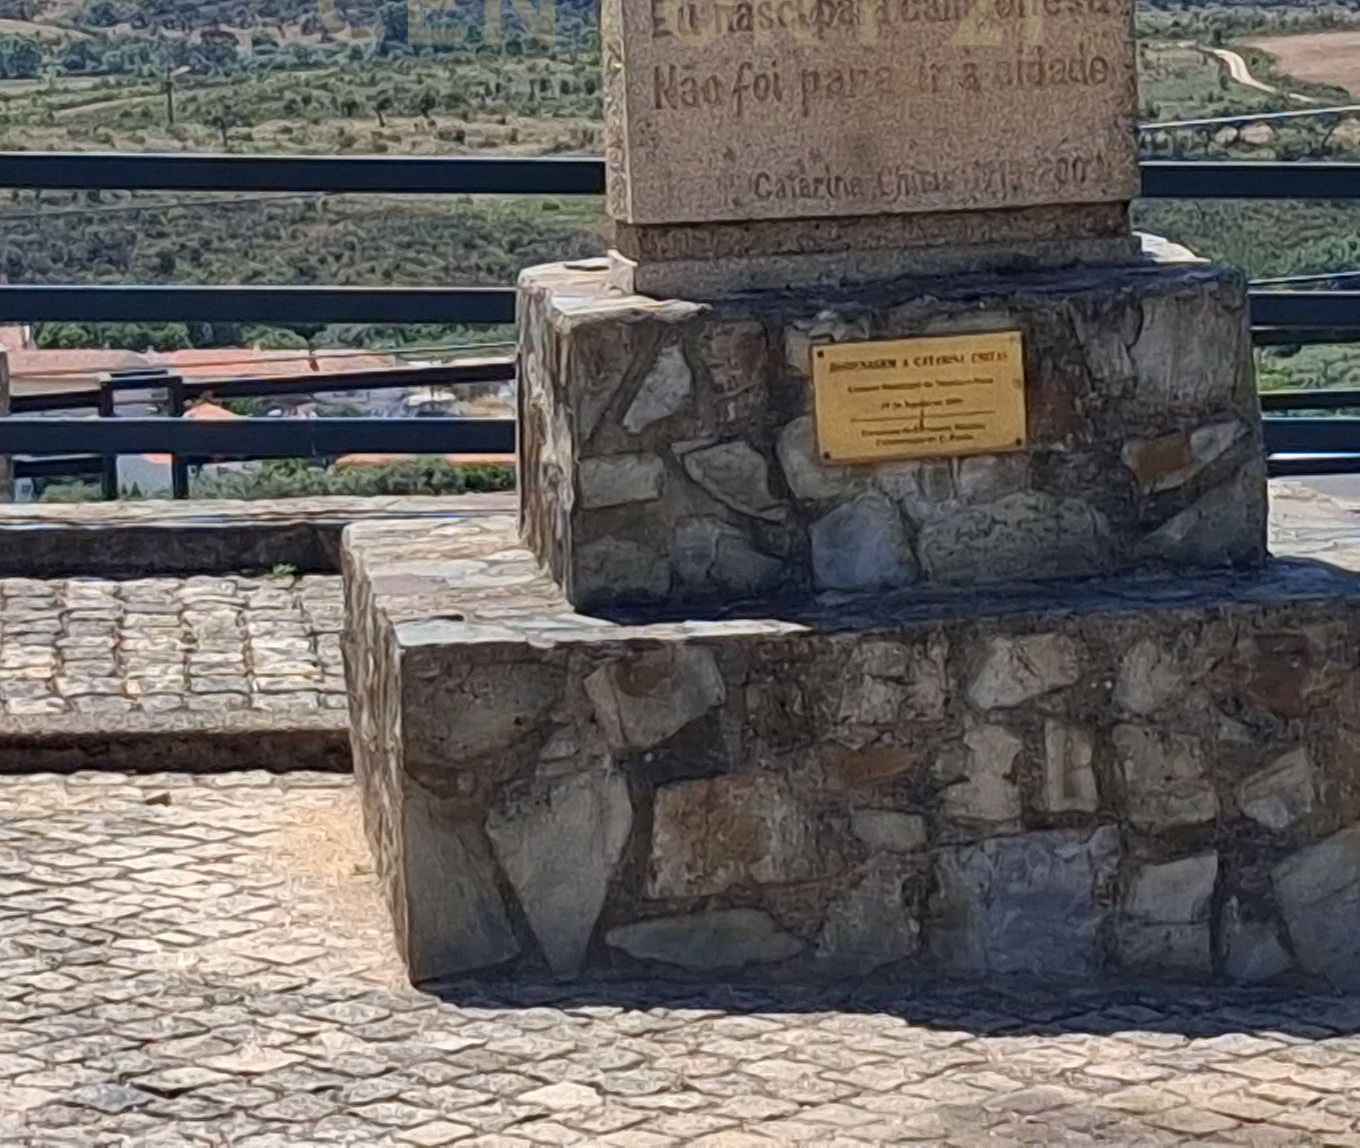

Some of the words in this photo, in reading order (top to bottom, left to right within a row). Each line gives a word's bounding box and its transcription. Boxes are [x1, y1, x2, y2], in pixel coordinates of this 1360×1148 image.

[654, 64, 722, 110] Não
[732, 61, 784, 117] foi
[801, 66, 891, 118] para
